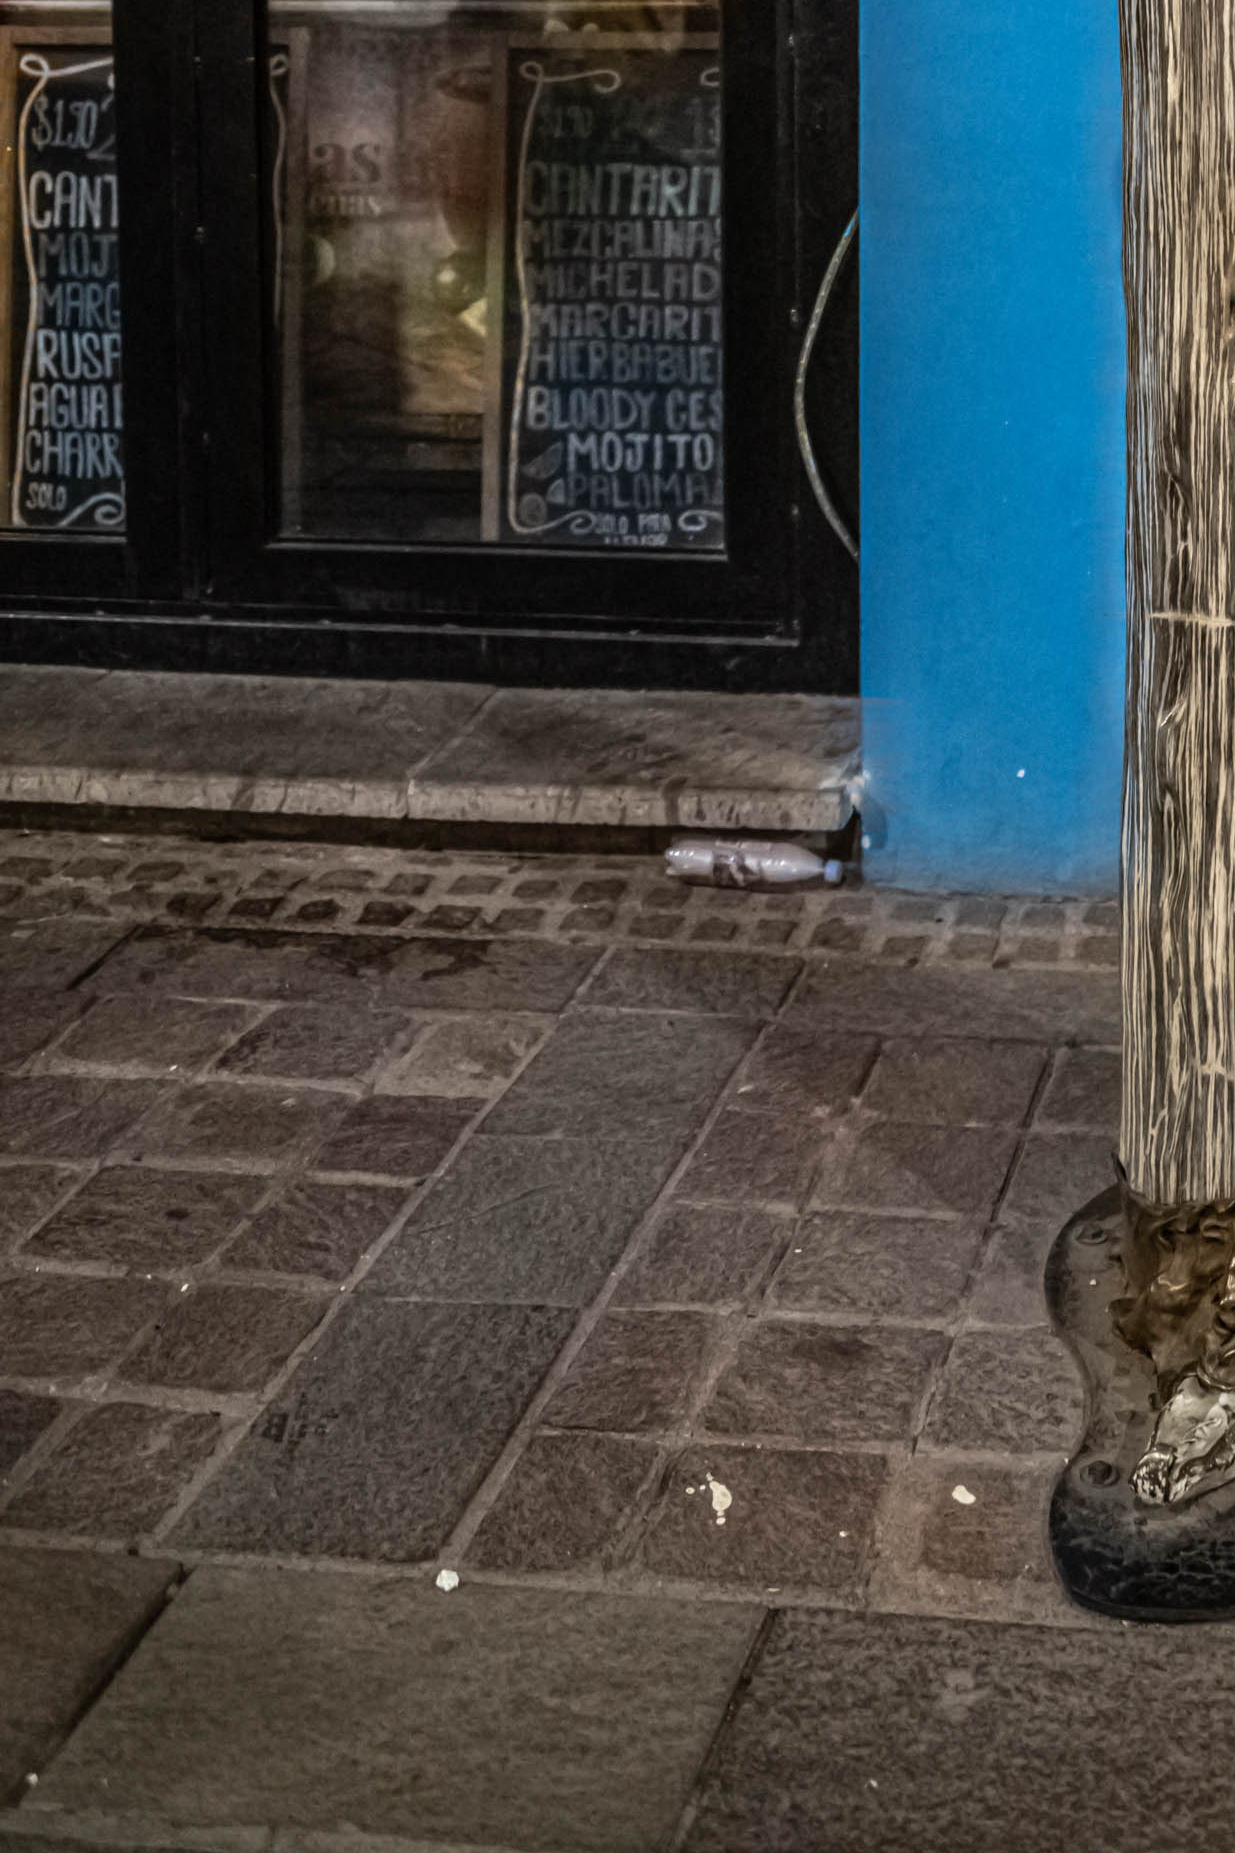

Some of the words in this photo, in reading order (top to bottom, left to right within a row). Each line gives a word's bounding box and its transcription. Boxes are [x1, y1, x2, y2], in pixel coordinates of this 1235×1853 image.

[526, 386, 656, 430] BLOODY
[567, 431, 715, 473] MOJITO
[26, 481, 67, 511] SOLO
